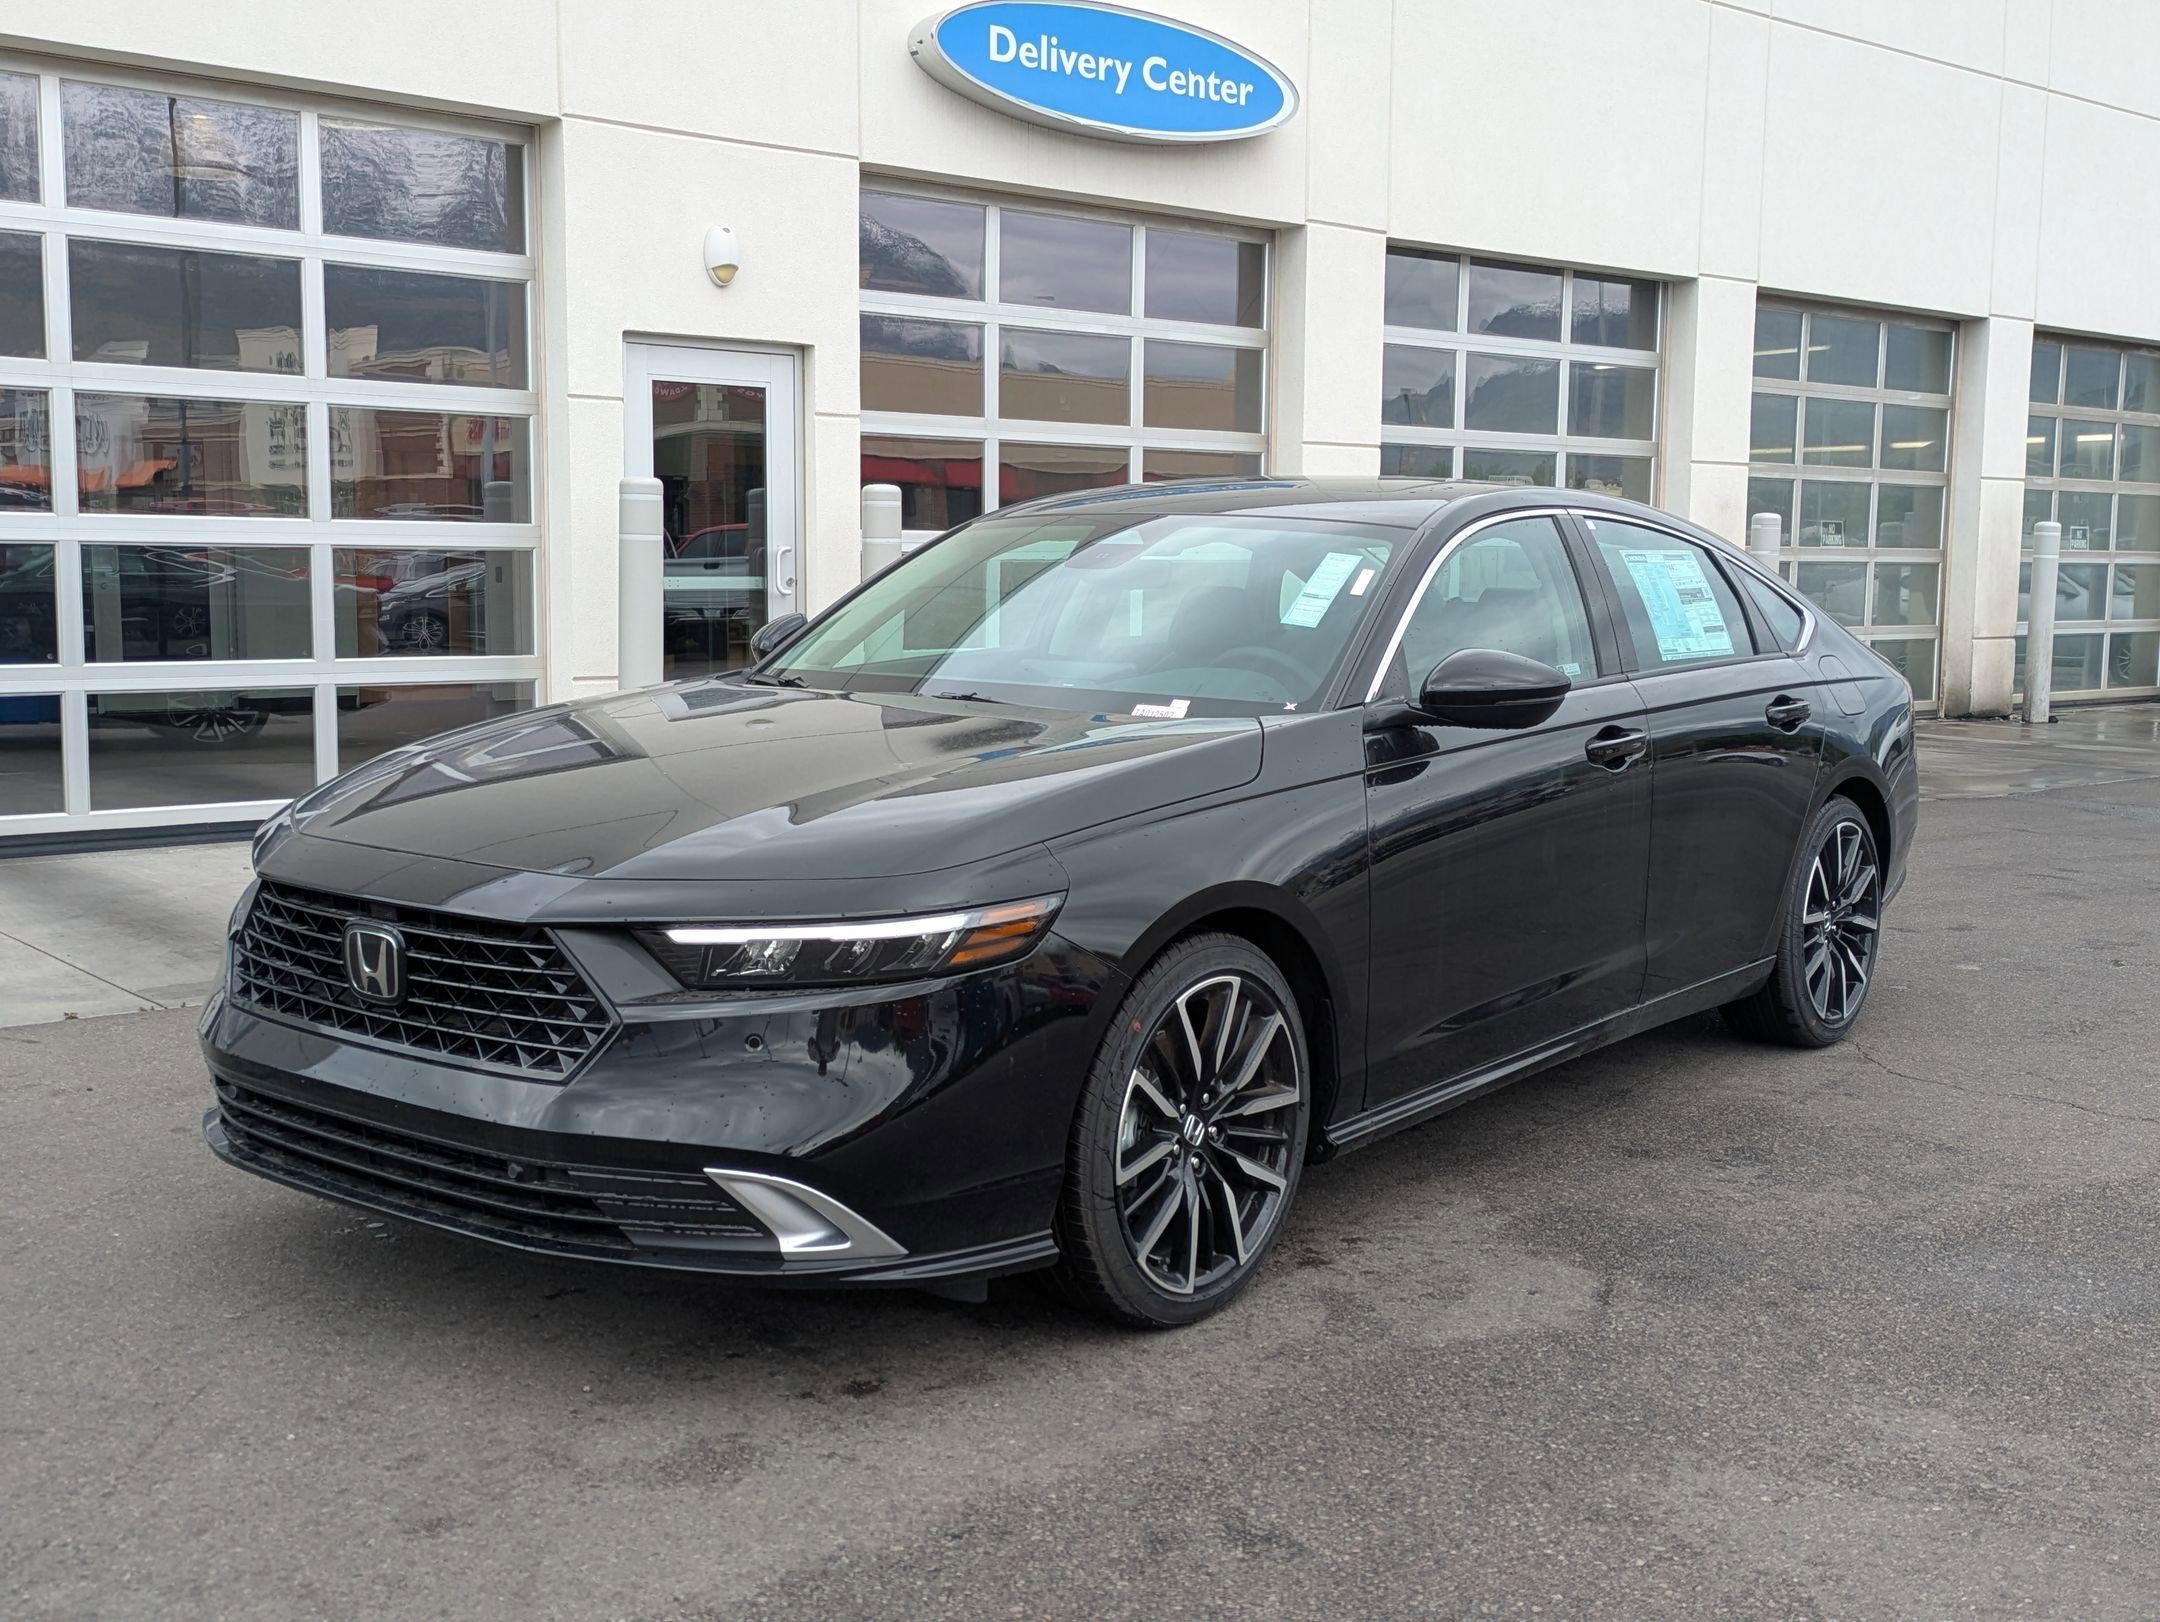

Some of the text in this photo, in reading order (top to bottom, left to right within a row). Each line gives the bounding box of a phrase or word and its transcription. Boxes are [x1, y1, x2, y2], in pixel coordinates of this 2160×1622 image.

[988, 23, 1254, 106] Delivery Center
[1828, 523, 1836, 534] NO
[1822, 534, 1842, 545] PARKING
